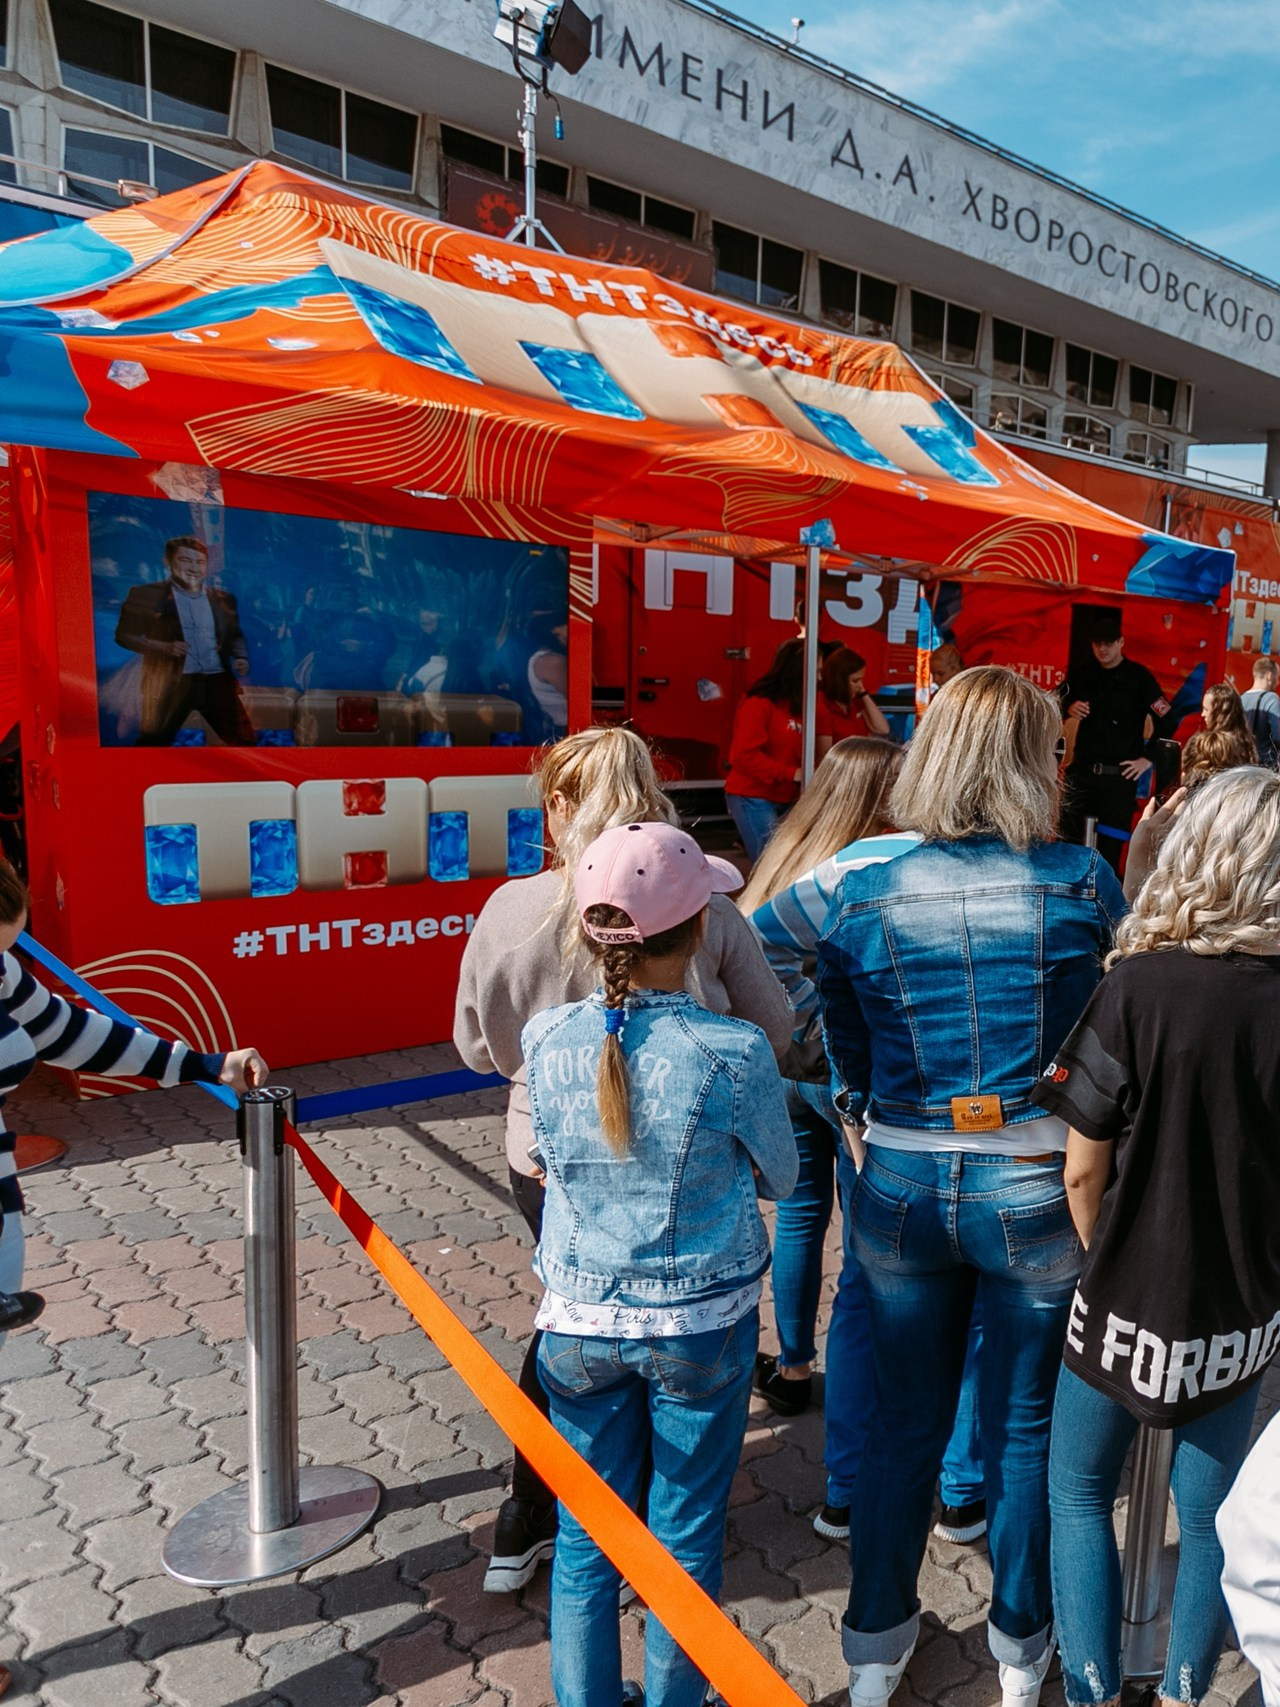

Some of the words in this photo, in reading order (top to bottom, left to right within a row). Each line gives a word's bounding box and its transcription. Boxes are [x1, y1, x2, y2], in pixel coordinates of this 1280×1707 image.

[961, 180, 1274, 342] ХВОРОСТОВСКОГО
[143, 775, 544, 906] ТНТ
[542, 1044, 673, 1098] FORER
